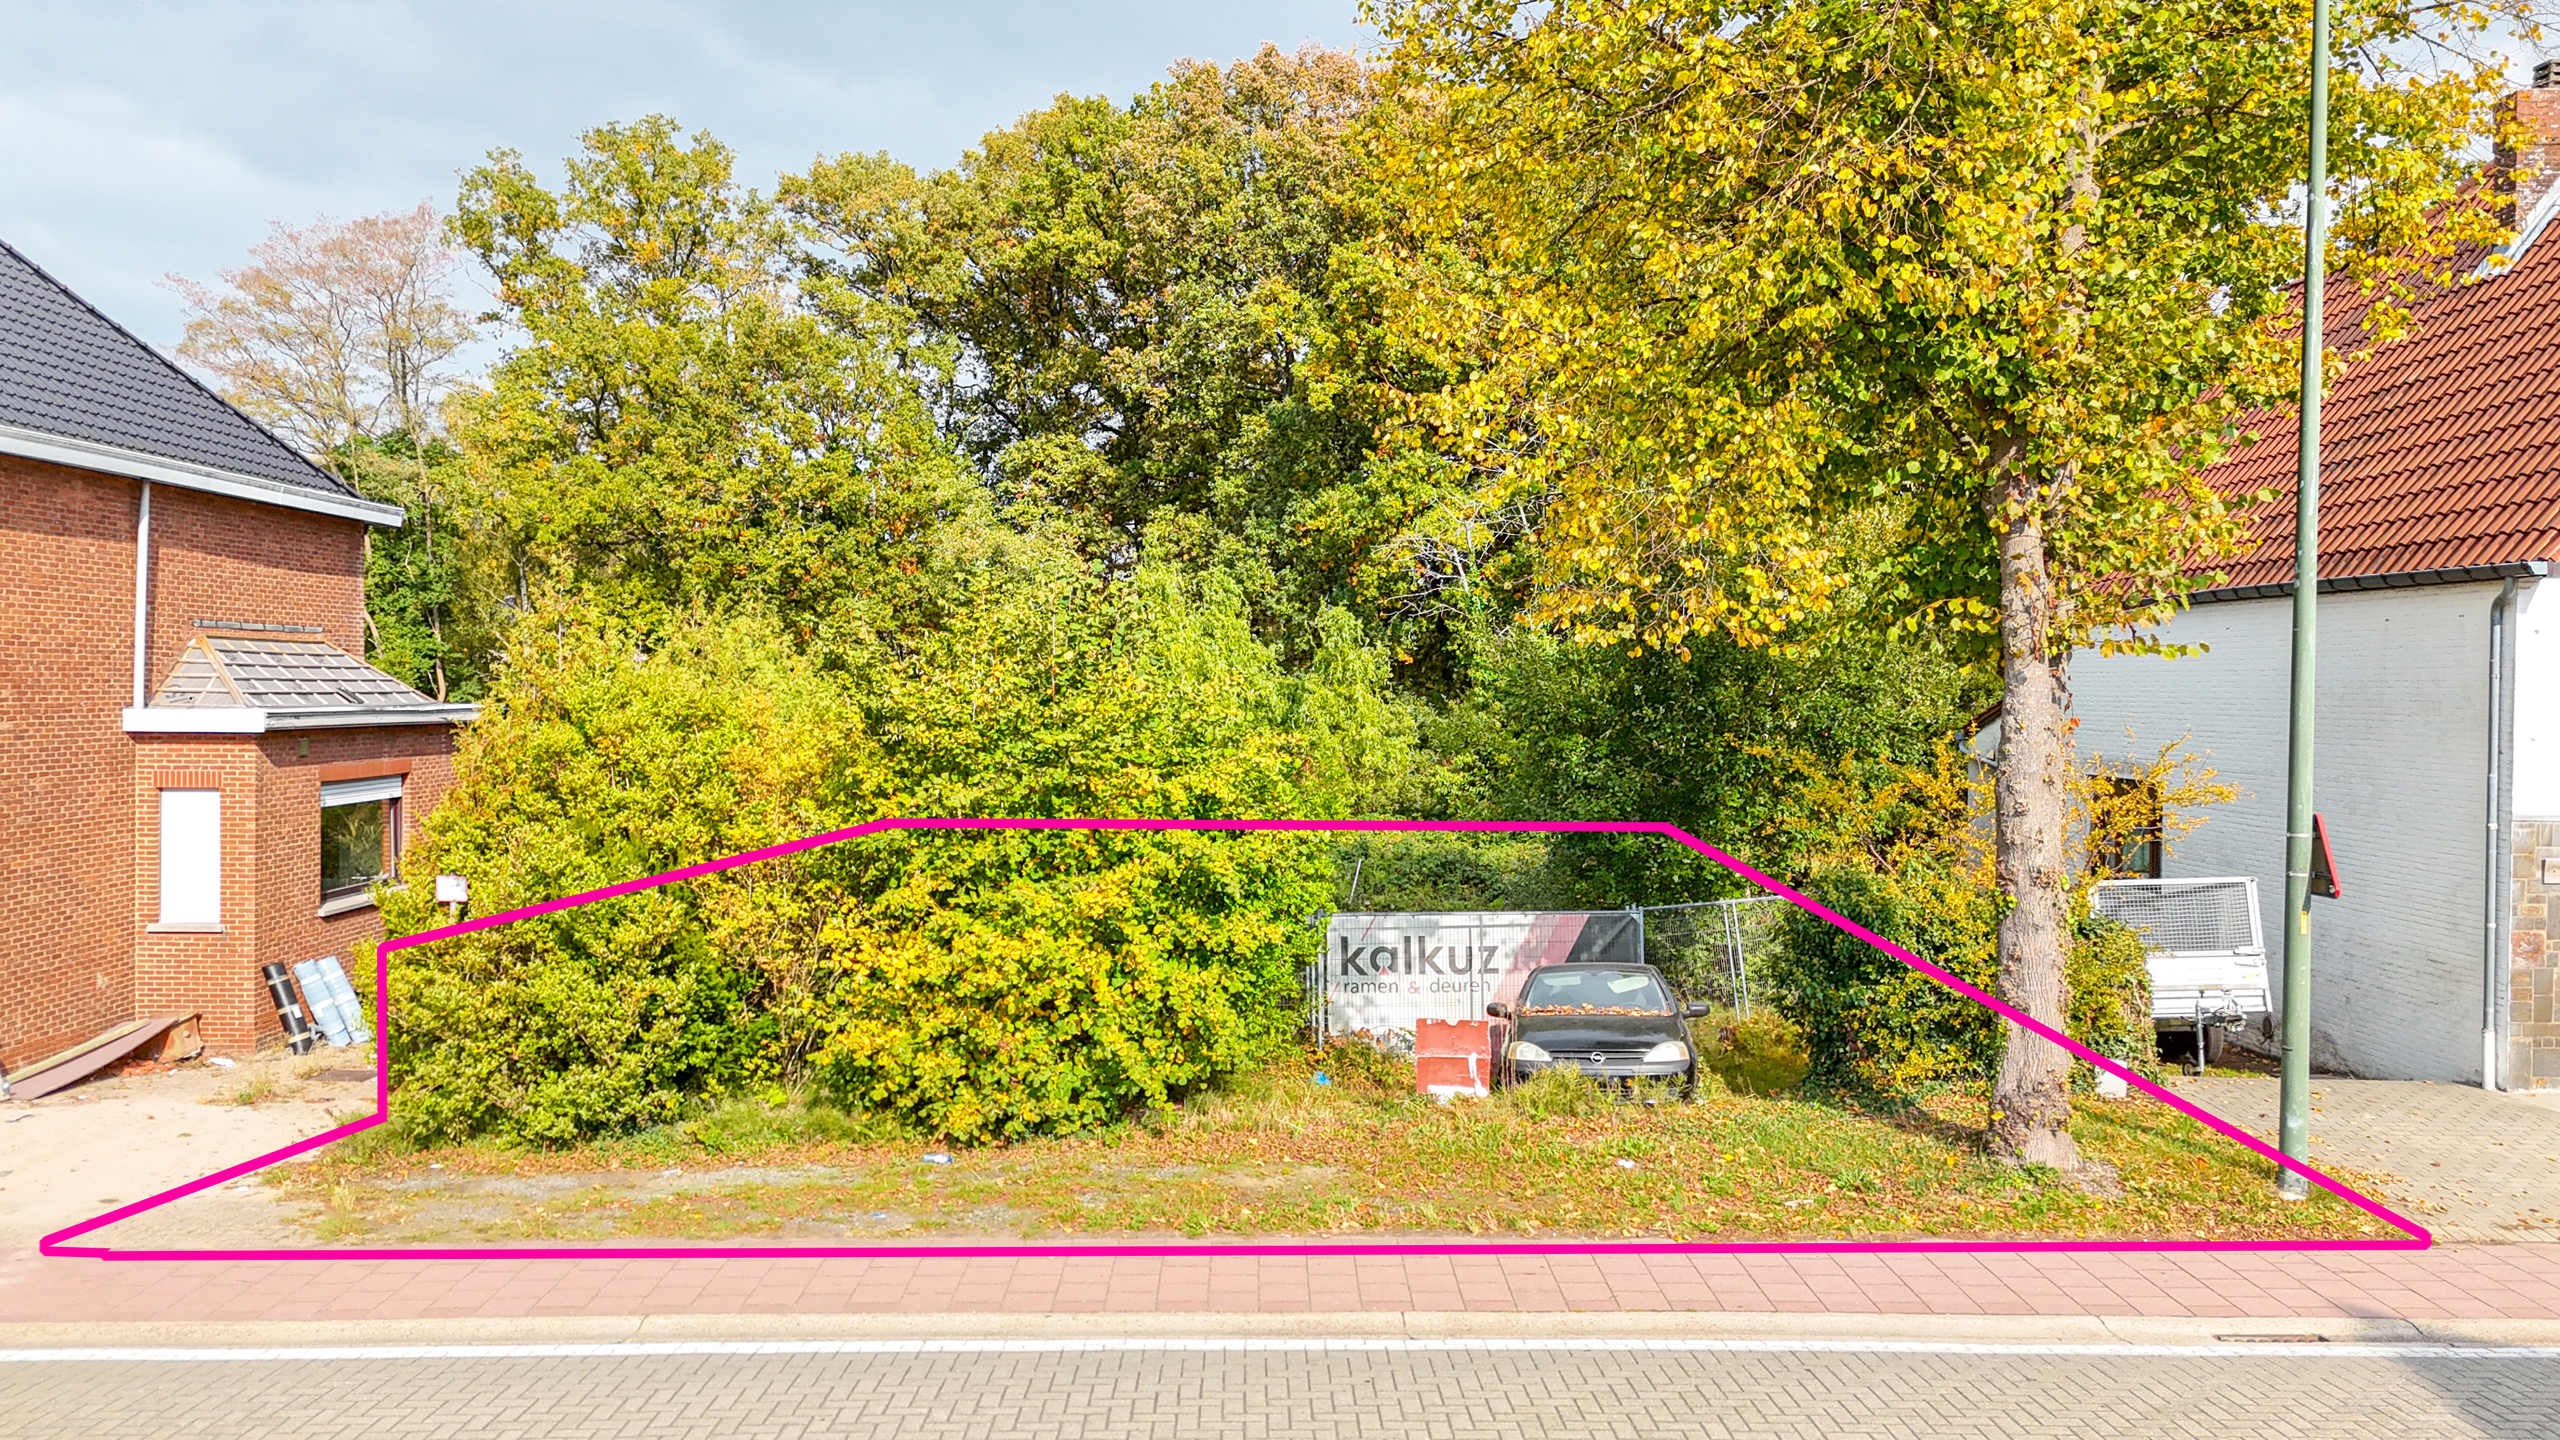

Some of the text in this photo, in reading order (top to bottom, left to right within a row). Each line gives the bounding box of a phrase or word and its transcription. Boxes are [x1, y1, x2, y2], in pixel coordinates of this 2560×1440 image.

[1341, 936, 1499, 976] kalkuz
[1344, 977, 1491, 994] ramen & deuren
